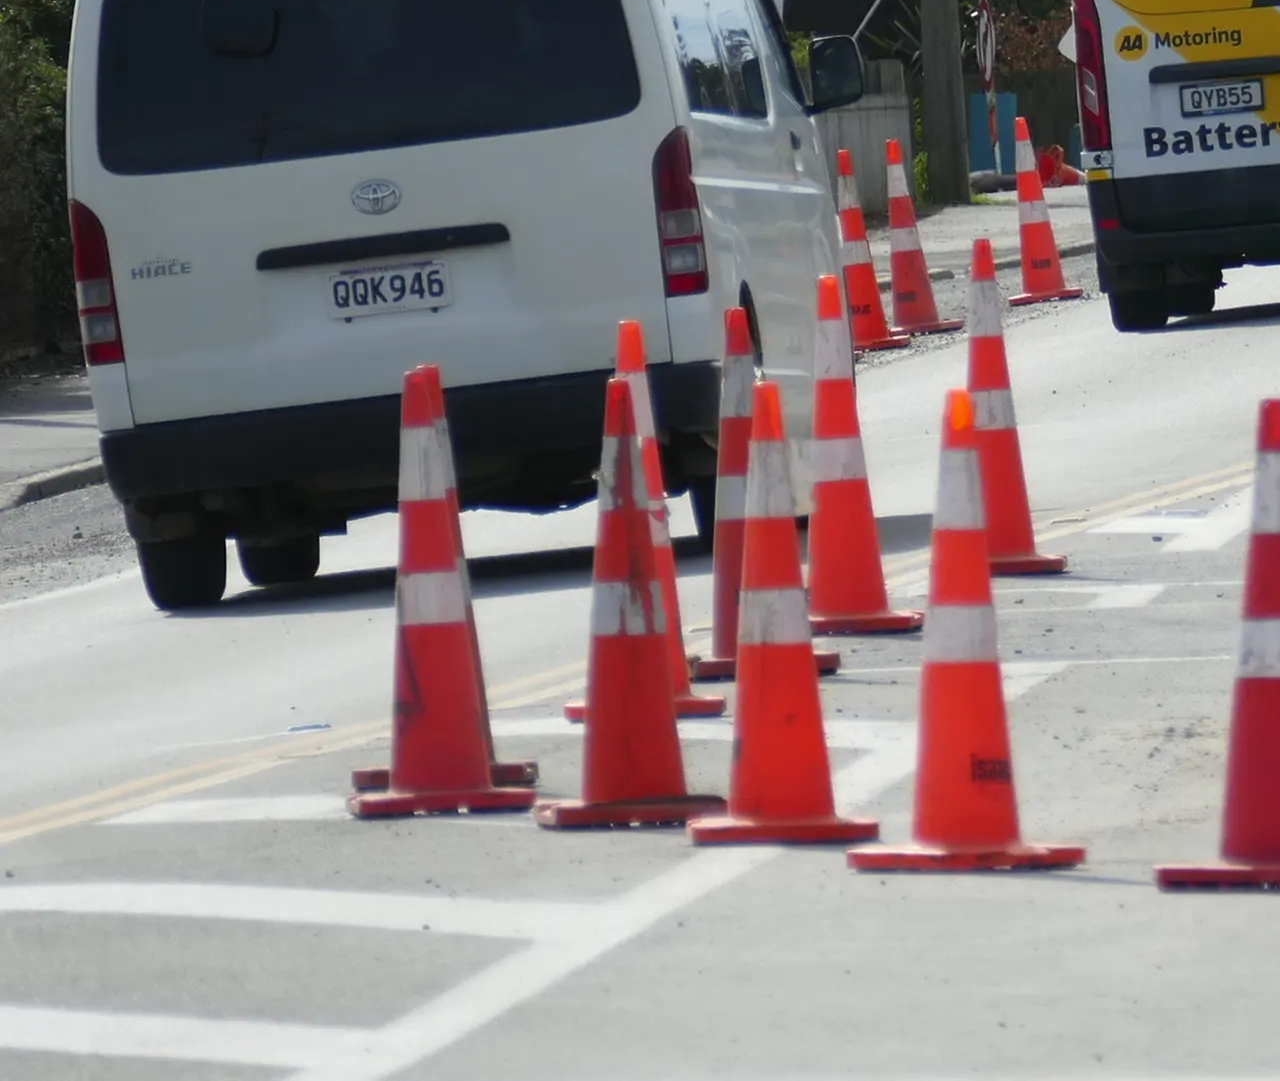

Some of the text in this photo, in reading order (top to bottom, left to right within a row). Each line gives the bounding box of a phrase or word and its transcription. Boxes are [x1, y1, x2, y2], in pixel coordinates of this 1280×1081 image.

[1119, 26, 1242, 52] AA Motoring
[1191, 85, 1253, 109] QYB55
[131, 261, 192, 280] HIACE
[333, 269, 444, 308] QQK946
